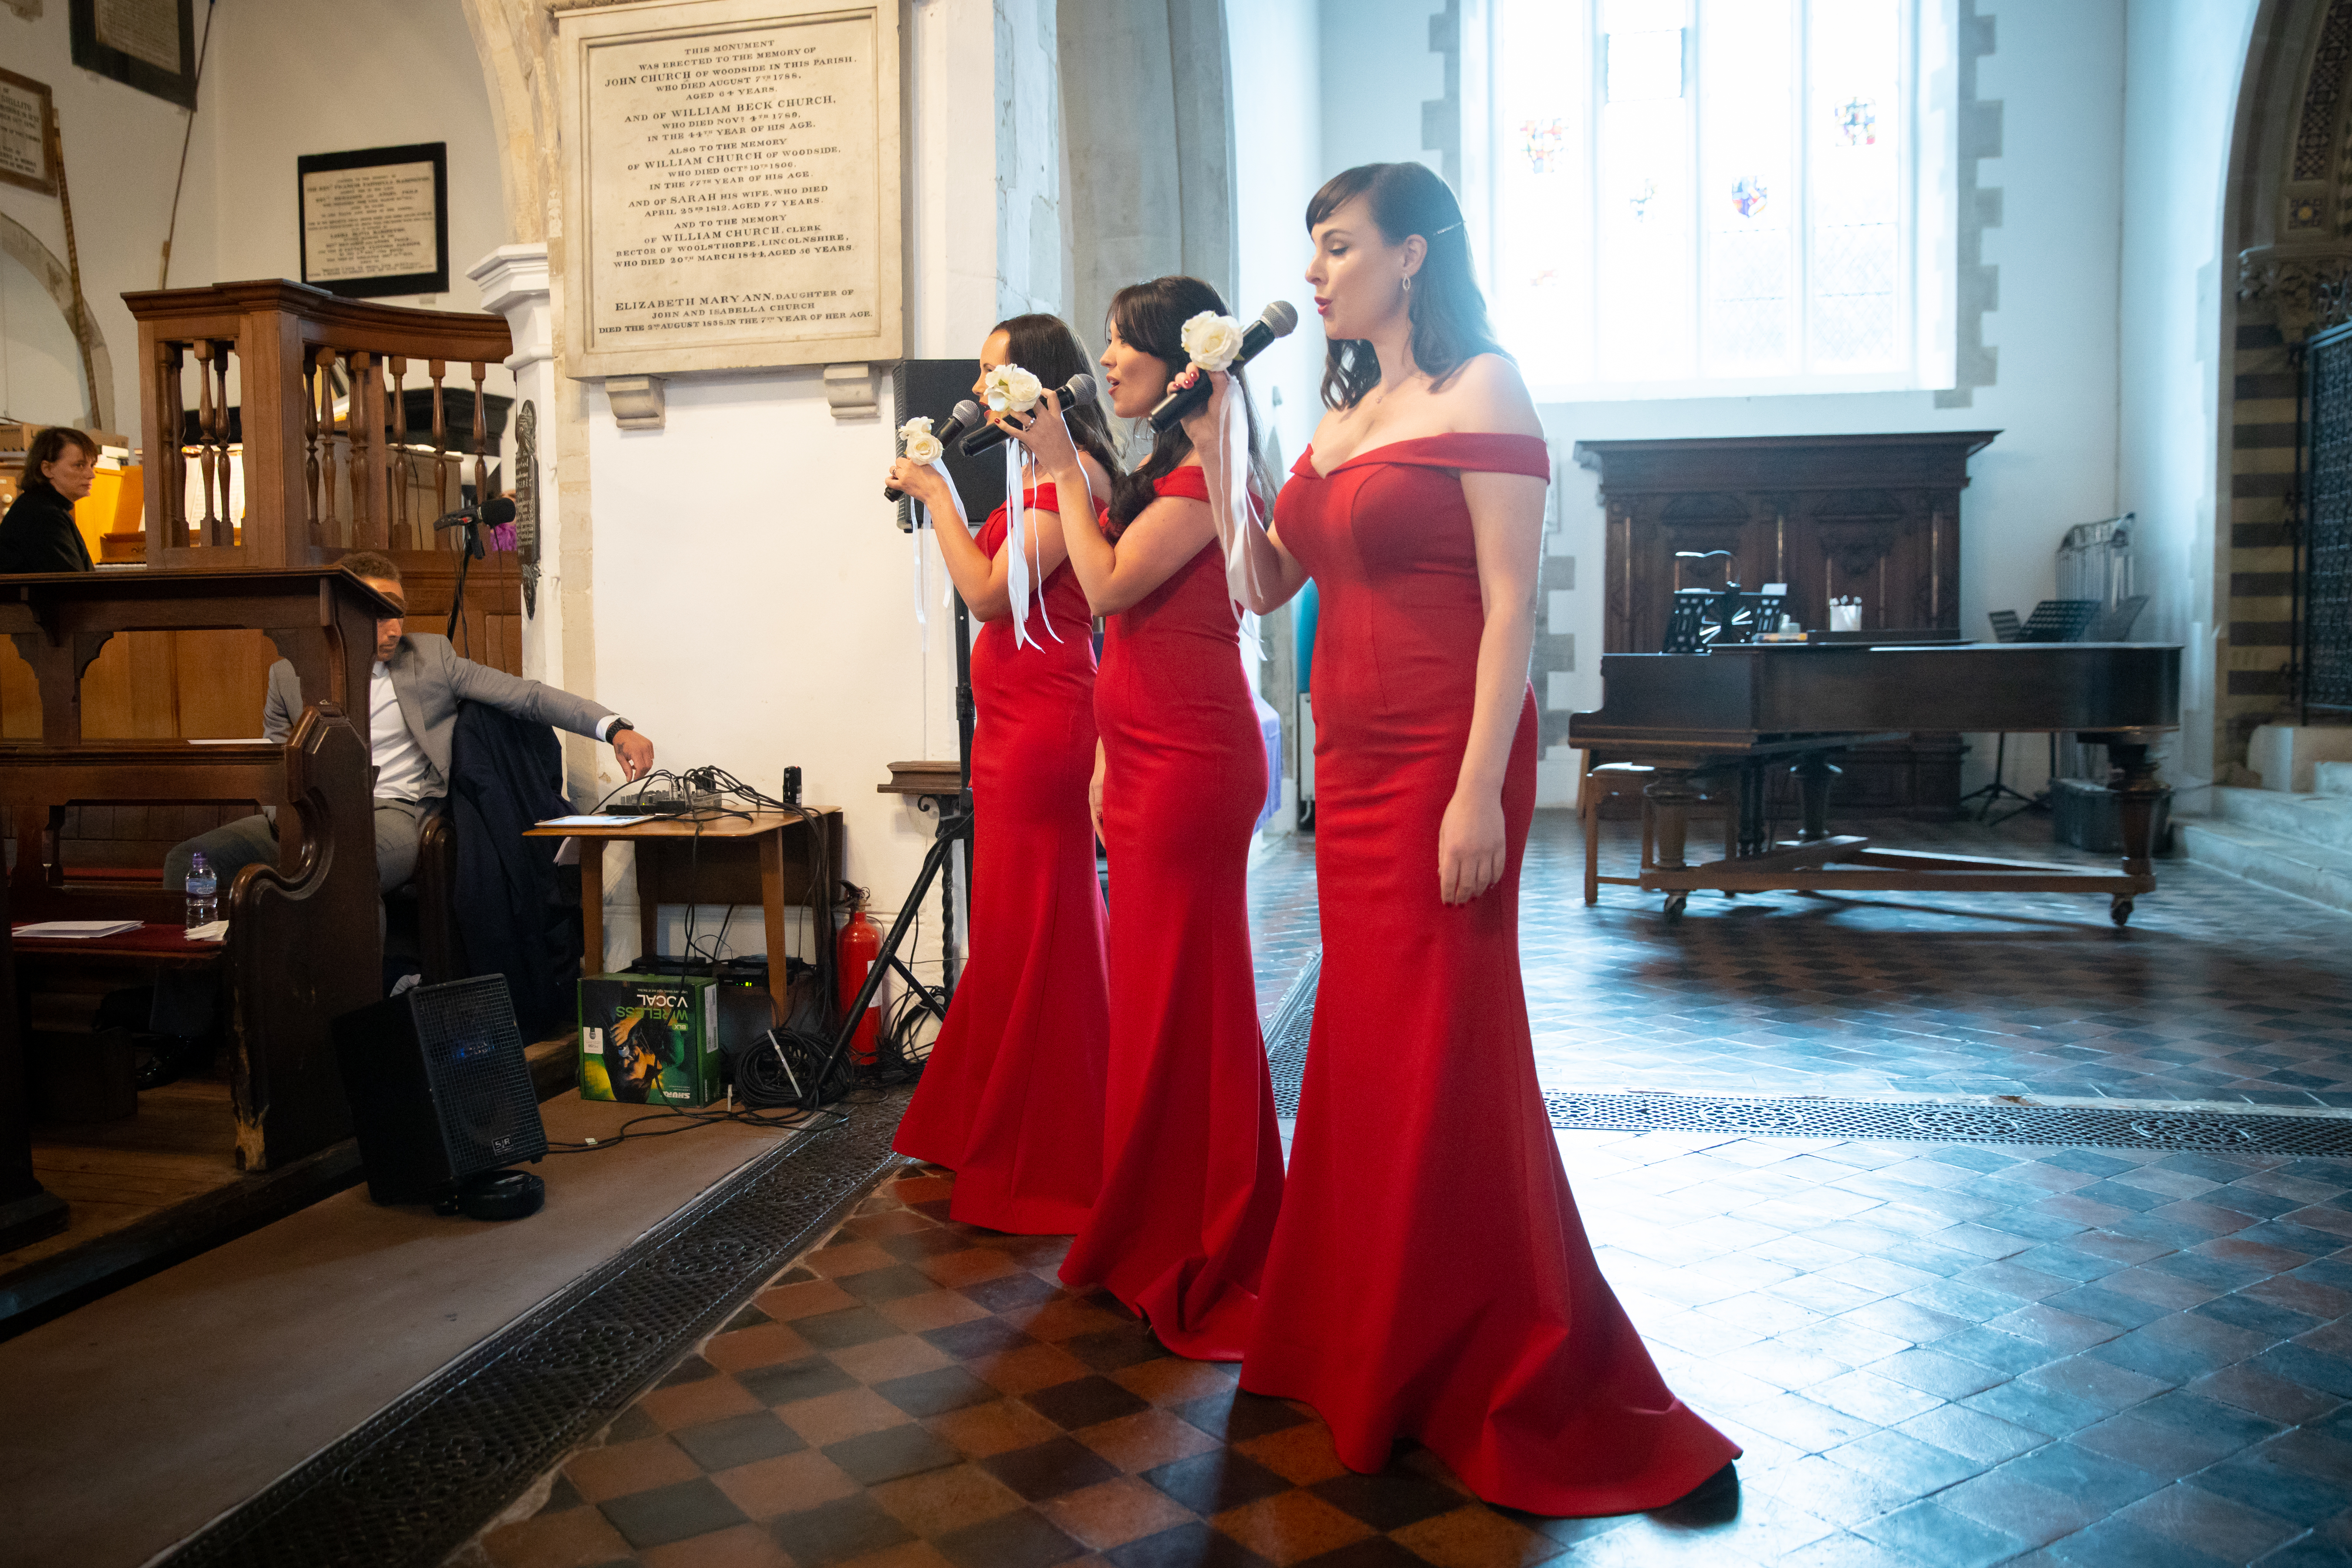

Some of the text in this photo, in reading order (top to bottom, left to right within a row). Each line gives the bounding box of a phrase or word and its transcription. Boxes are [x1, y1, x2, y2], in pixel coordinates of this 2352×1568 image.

[684, 40, 775, 55] THIS MONUMENT
[662, 57, 713, 69] ERECTED
[732, 53, 753, 61] THE
[757, 48, 801, 59] MEMORY
[605, 76, 637, 87] JOHN
[640, 71, 691, 82] CHURCH
[712, 64, 766, 76] WOODSIDE
[783, 61, 810, 69] THIS
[680, 81, 706, 90] DIED
[709, 77, 751, 88] AUGUST
[686, 92, 714, 101] AGED
[624, 114, 648, 123] AND
[671, 105, 730, 118] WILLIAM
[737, 101, 773, 112] BECK
[662, 132, 684, 141] THE
[716, 127, 746, 136] YEAR
[767, 123, 785, 132] HIS
[789, 121, 815, 130] AGE.
[688, 119, 714, 128] DIED
[668, 146, 696, 155] ALSO
[740, 138, 787, 149] MEMORY
[644, 156, 702, 169] WILLIAM
[706, 151, 762, 164] CHURCH
[664, 181, 685, 189] THE
[714, 176, 744, 185] YEAR
[787, 171, 814, 179] AGE.
[694, 168, 720, 176] DIED
[628, 199, 650, 208] AND
[670, 193, 716, 204] SARAH
[801, 185, 828, 194] DIED
[645, 209, 677, 217] APRIL
[732, 202, 760, 210] AGED
[716, 218, 738, 226] THE
[741, 214, 787, 224] MEMORY
[662, 230, 721, 242] WILLIAM
[786, 224, 821, 233] CLERK
[616, 248, 656, 257] RECTOR
[640, 258, 666, 266] DIED
[697, 253, 735, 262] MARCH
[767, 248, 797, 257] AGED
[615, 297, 695, 311] ELIZABETH
[700, 295, 740, 305] MARY
[776, 290, 837, 300] DAUGHTER
[652, 311, 679, 319] JOHN
[709, 305, 765, 315] ISABELLA
[769, 302, 815, 311] CHURCH
[598, 326, 622, 334] DIED
[660, 321, 700, 330] AUGUST
[637, 994, 688, 1008] VOCAL
[616, 1006, 688, 1021] WIRELESS
